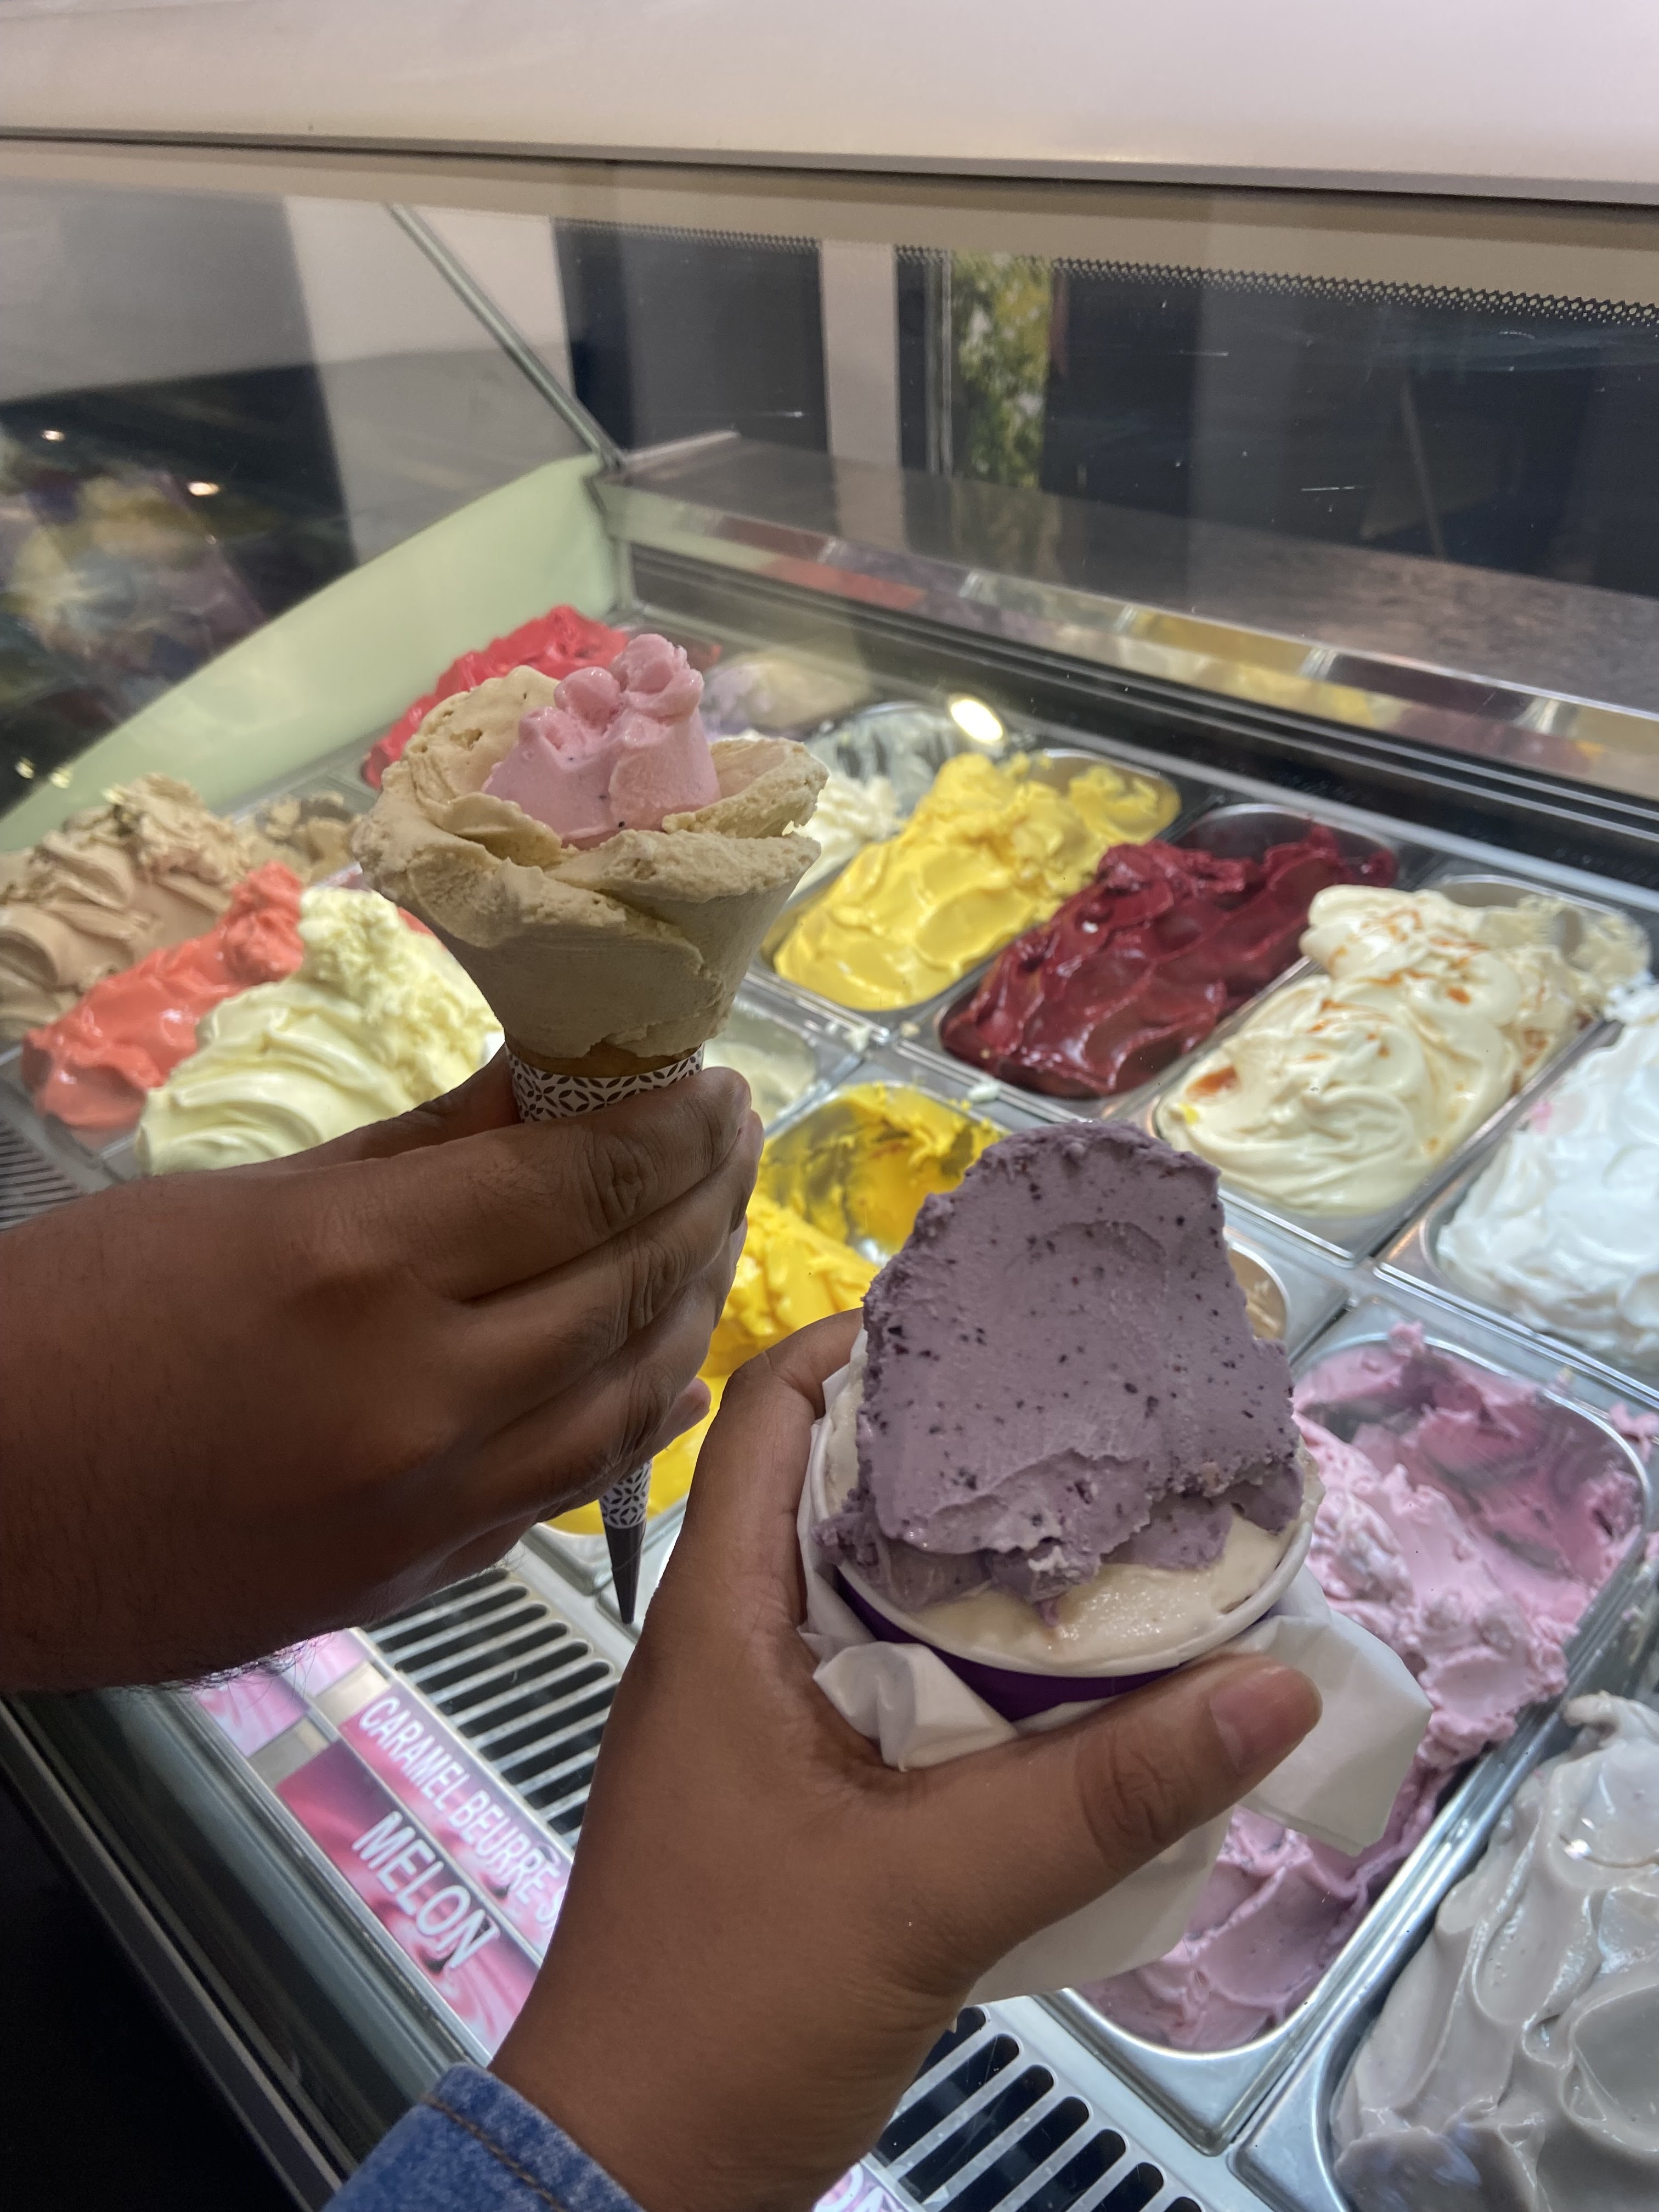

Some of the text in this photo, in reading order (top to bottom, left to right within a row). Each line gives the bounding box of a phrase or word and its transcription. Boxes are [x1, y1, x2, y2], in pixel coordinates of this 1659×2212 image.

[351, 1810, 500, 1969] MELON
[359, 1696, 470, 1812] CARAMEL
[448, 1790, 561, 1905] BEURRE
